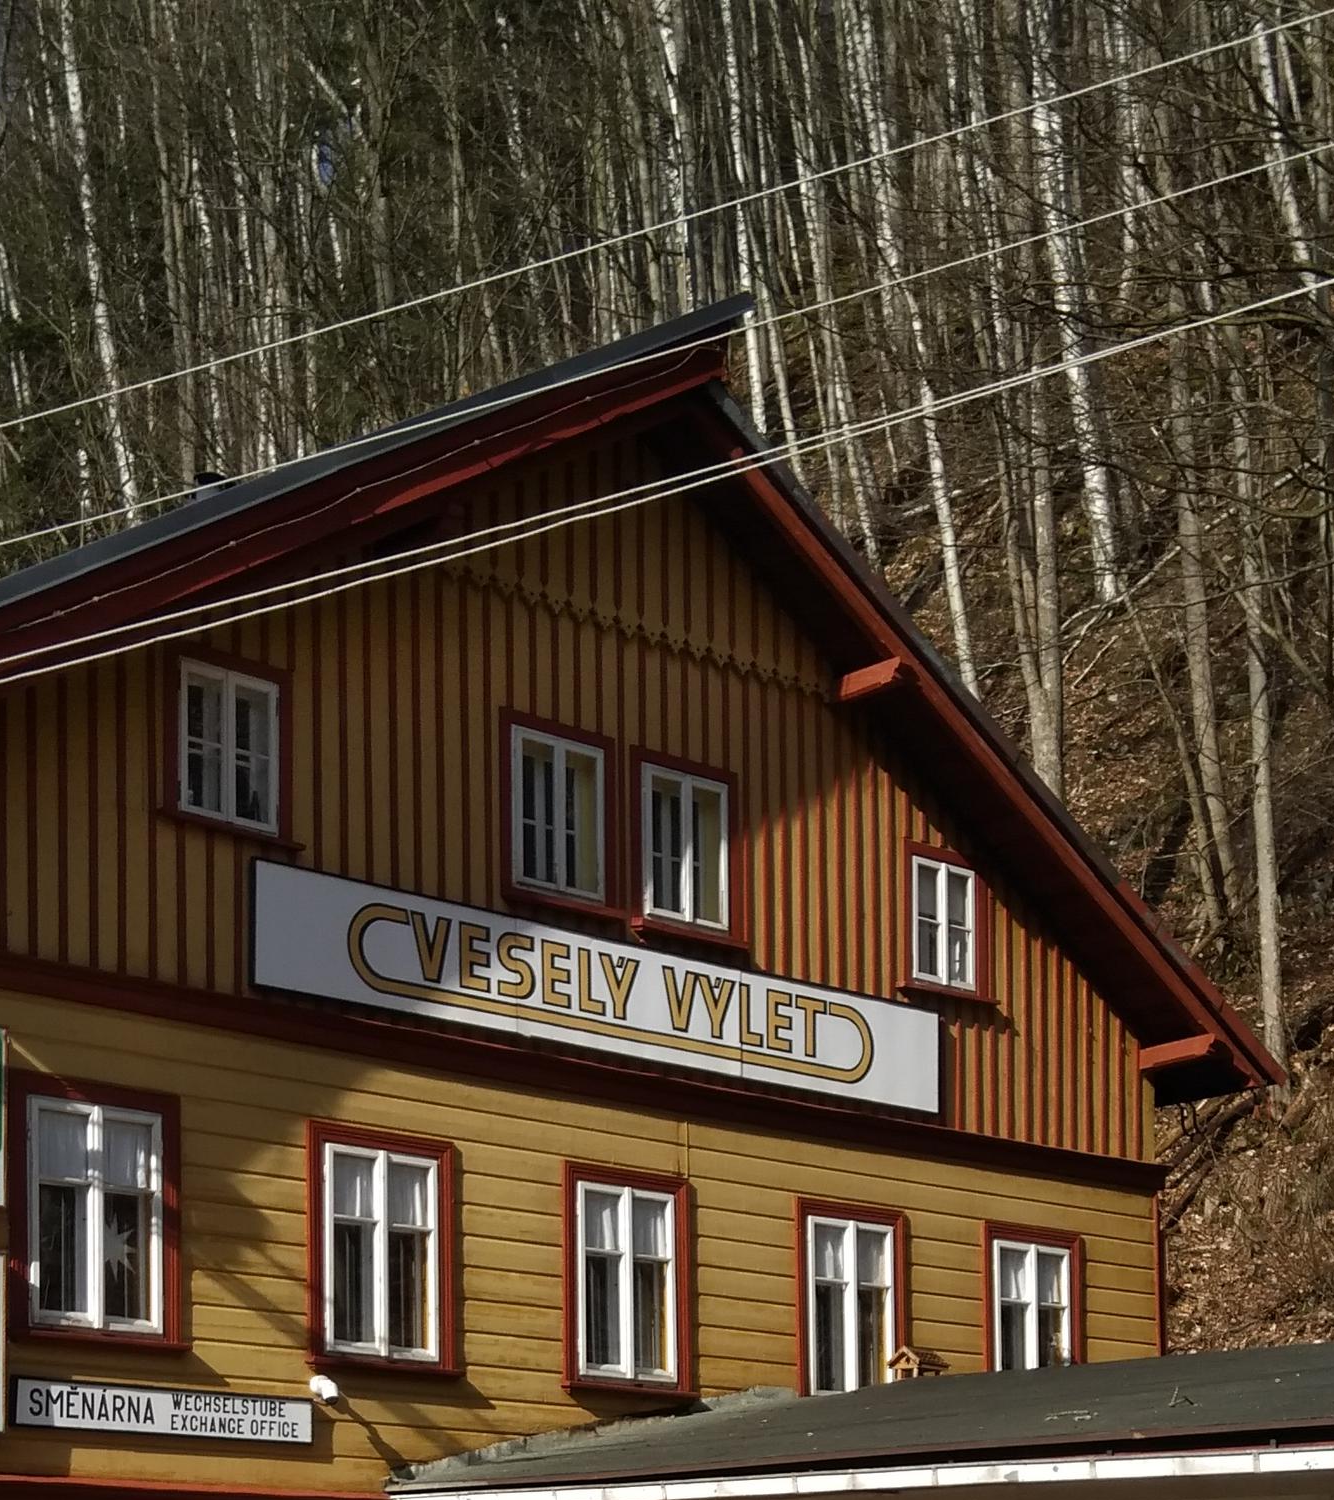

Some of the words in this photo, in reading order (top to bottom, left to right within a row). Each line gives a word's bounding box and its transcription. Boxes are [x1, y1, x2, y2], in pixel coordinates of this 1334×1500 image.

[408, 909, 640, 1020] VESELÝ
[662, 965, 829, 1057] VÝLET
[29, 1386, 156, 1425] SMĚNÁRNA
[171, 1393, 286, 1418] WECHSELSTUBE
[171, 1414, 244, 1434] EXCHANGE
[250, 1420, 299, 1438] OFFICE
